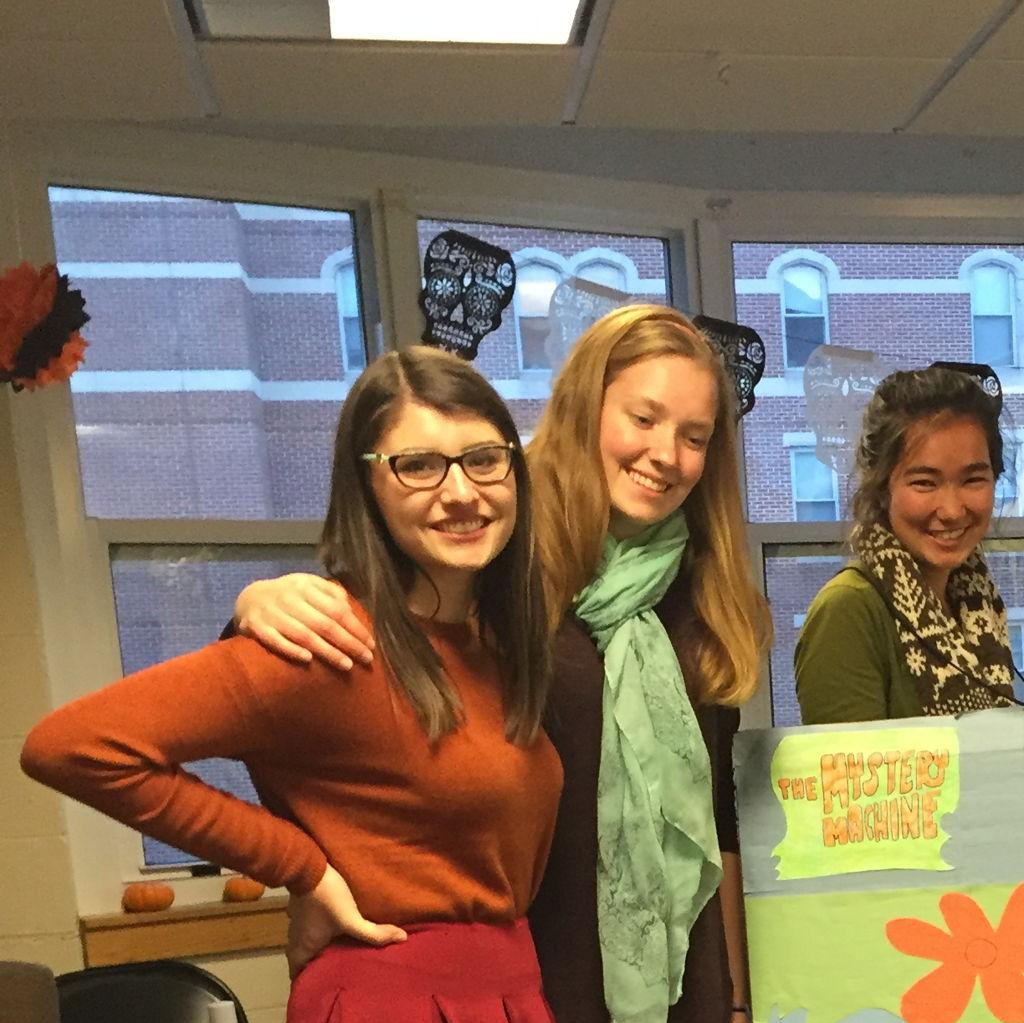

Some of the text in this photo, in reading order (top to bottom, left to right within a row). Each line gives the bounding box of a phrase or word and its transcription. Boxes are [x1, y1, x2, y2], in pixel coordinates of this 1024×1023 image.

[778, 749, 949, 814] THE MYSTERY
[822, 790, 940, 847] MACHINE
